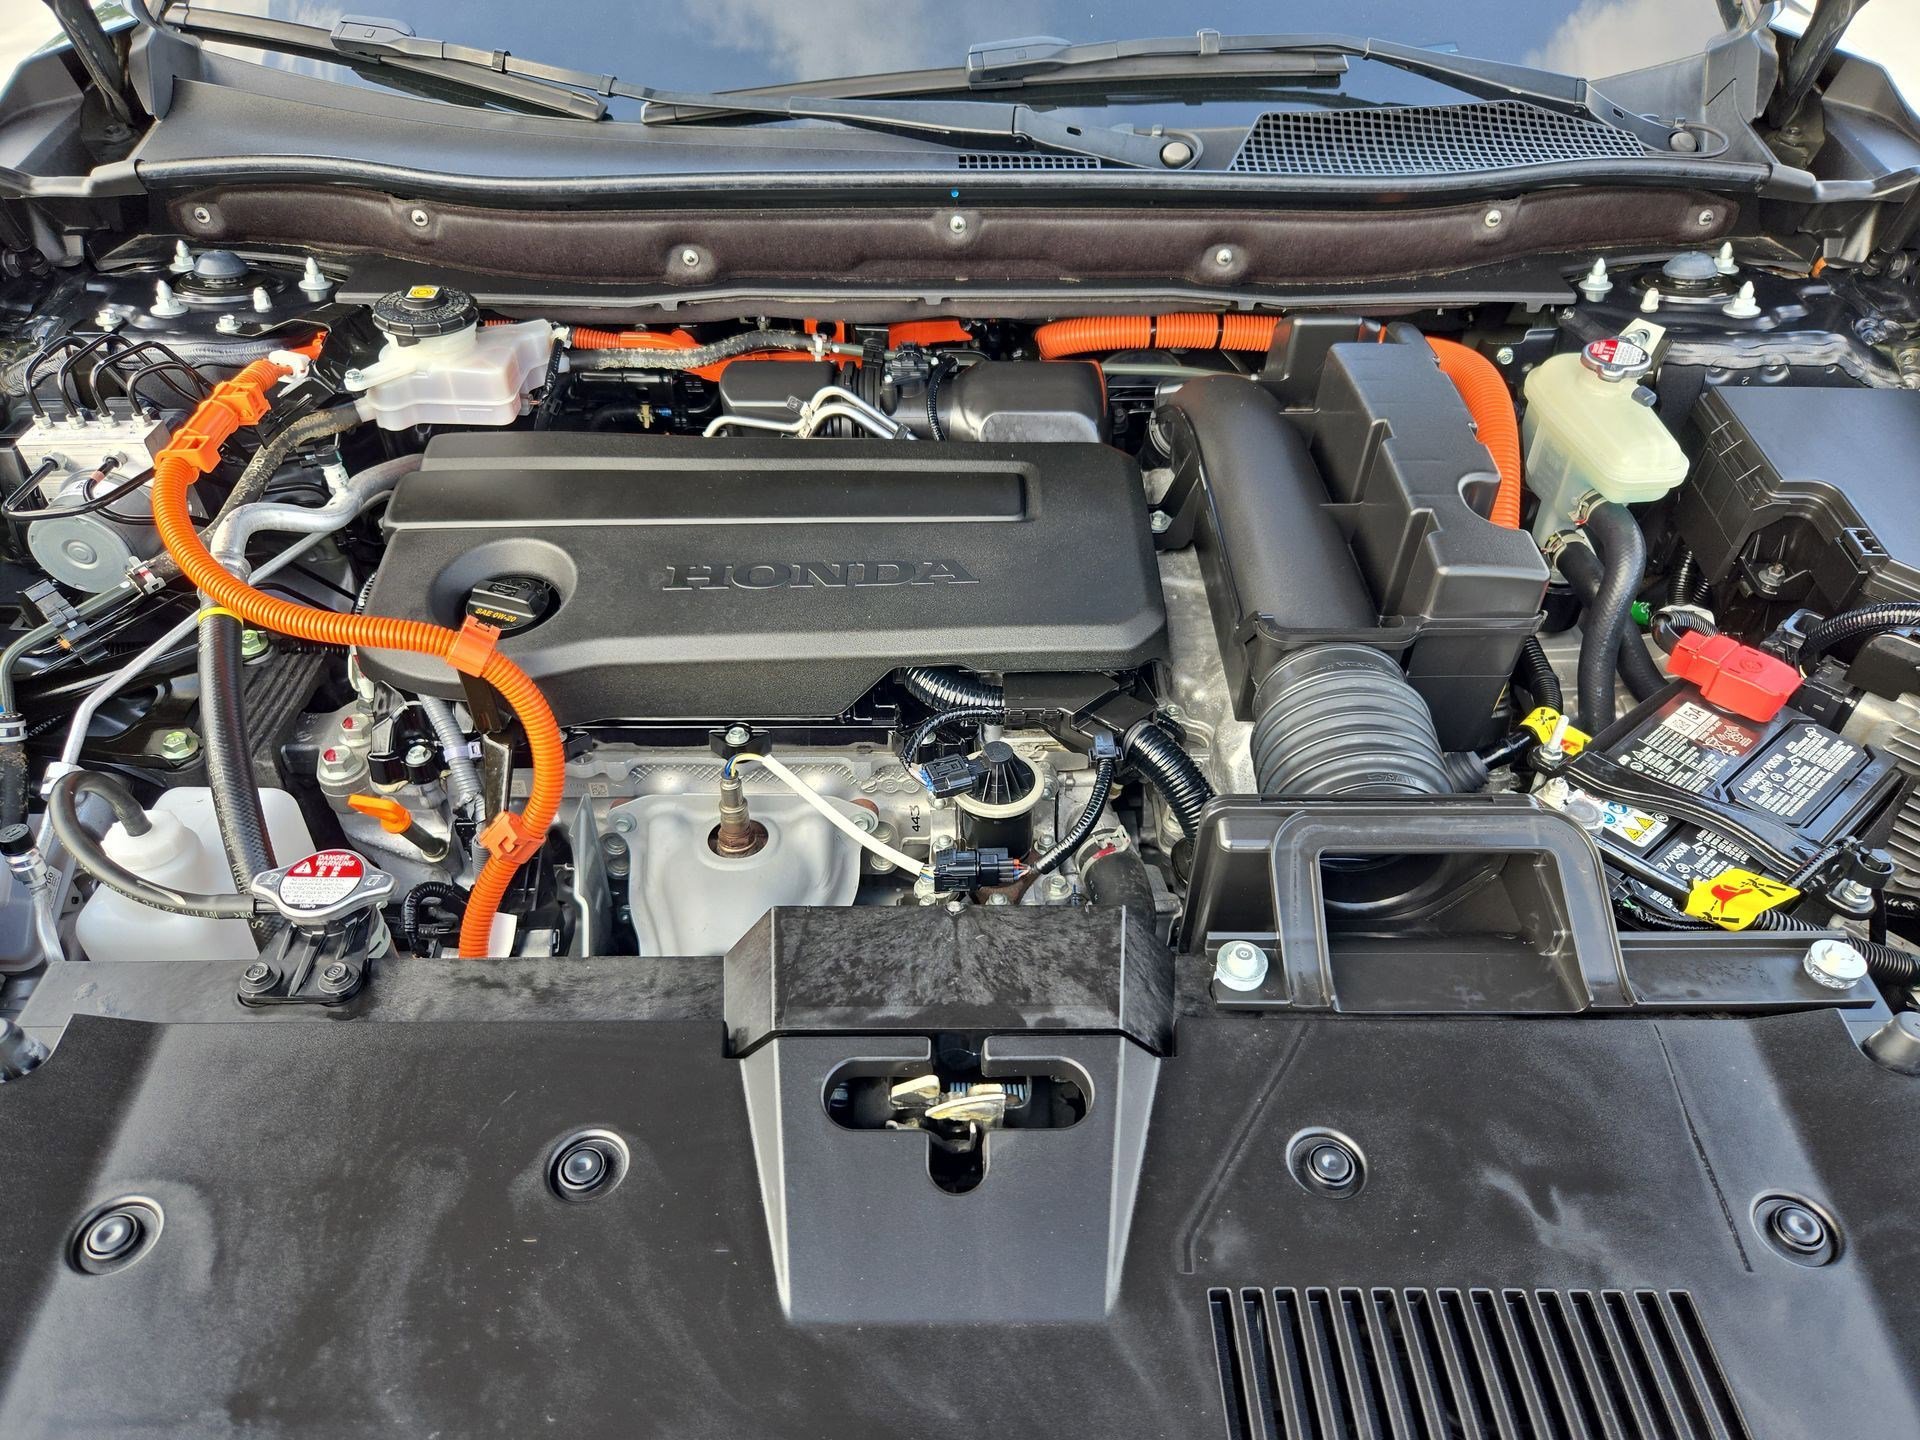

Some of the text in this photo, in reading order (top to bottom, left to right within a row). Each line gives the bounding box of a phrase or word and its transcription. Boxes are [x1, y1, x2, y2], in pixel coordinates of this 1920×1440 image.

[662, 559, 980, 591] HONDA
[475, 607, 518, 623] SAE 0W-20
[1683, 705, 1706, 721] 5A
